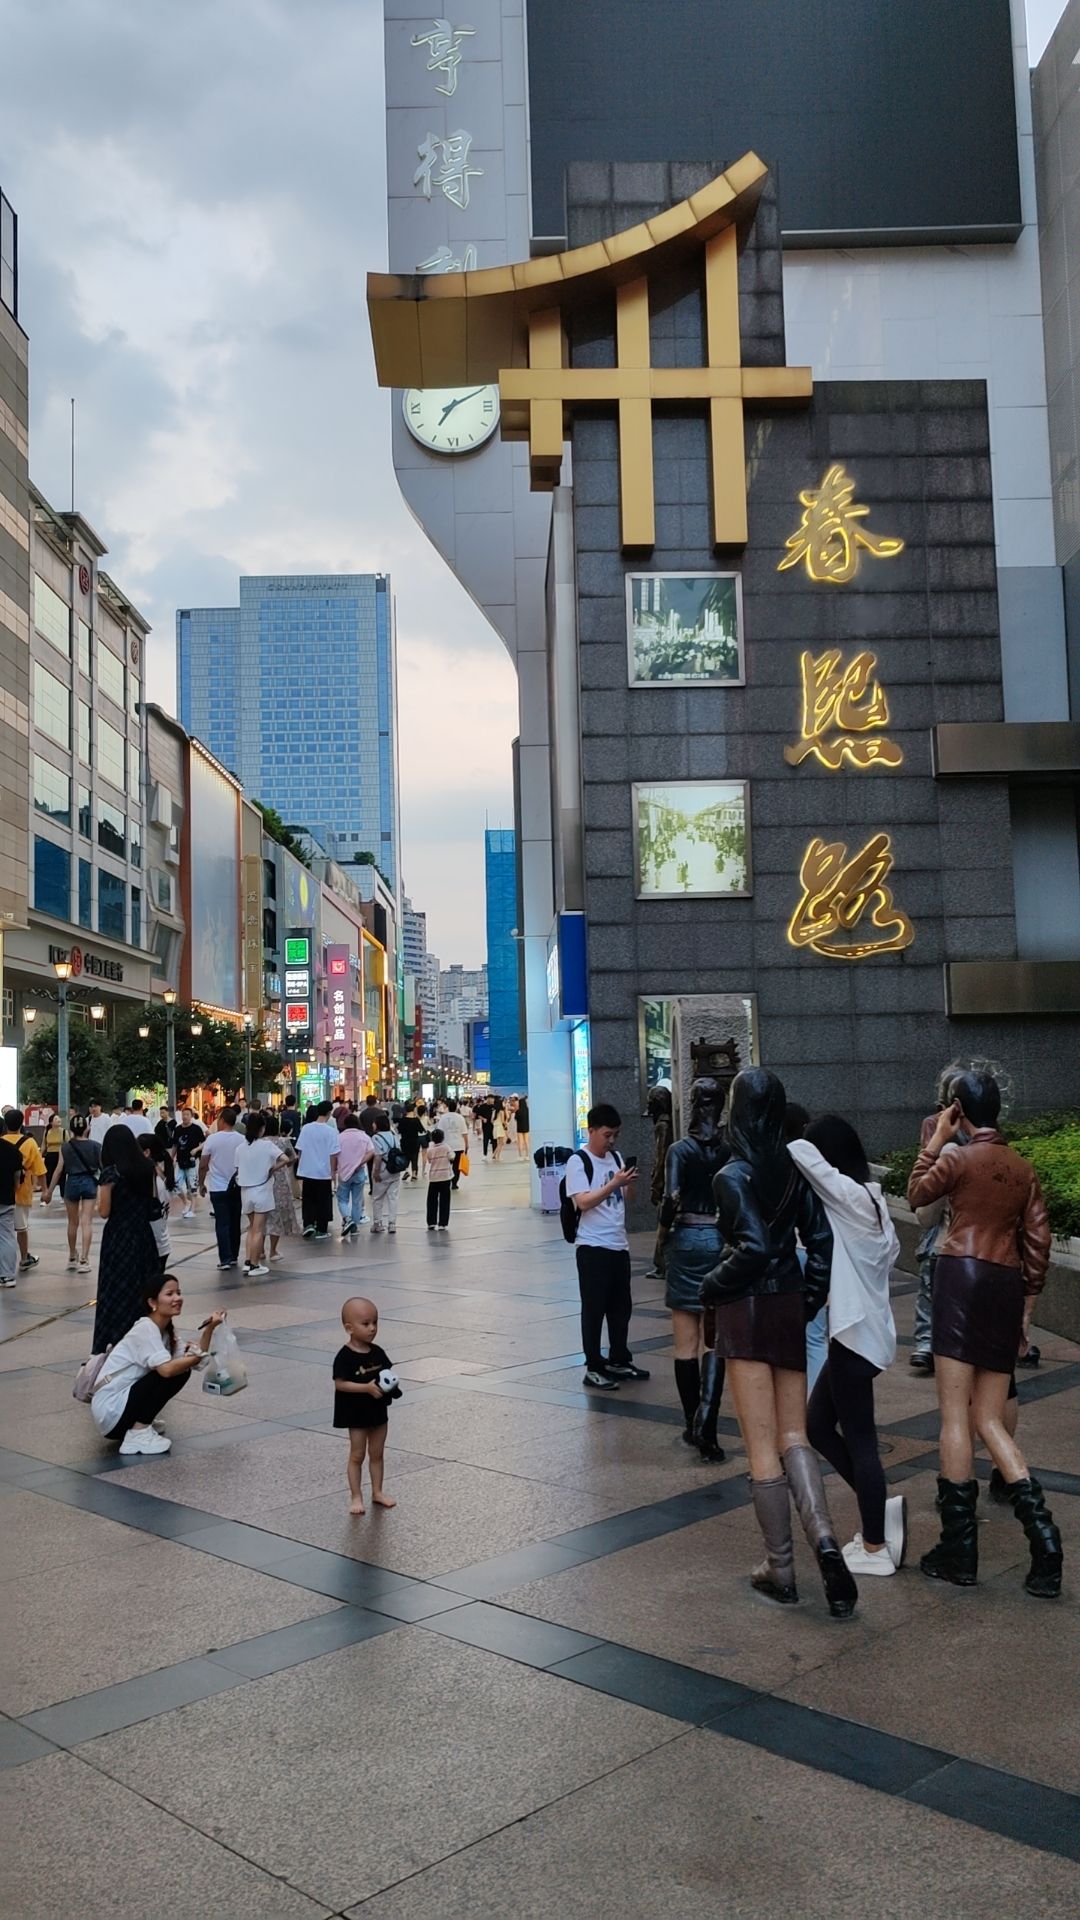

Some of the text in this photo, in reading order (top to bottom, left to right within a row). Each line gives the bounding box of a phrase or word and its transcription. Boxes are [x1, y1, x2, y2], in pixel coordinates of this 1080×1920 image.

[776, 464, 915, 959] 春熙路
[333, 989, 345, 1040] 名创优品
